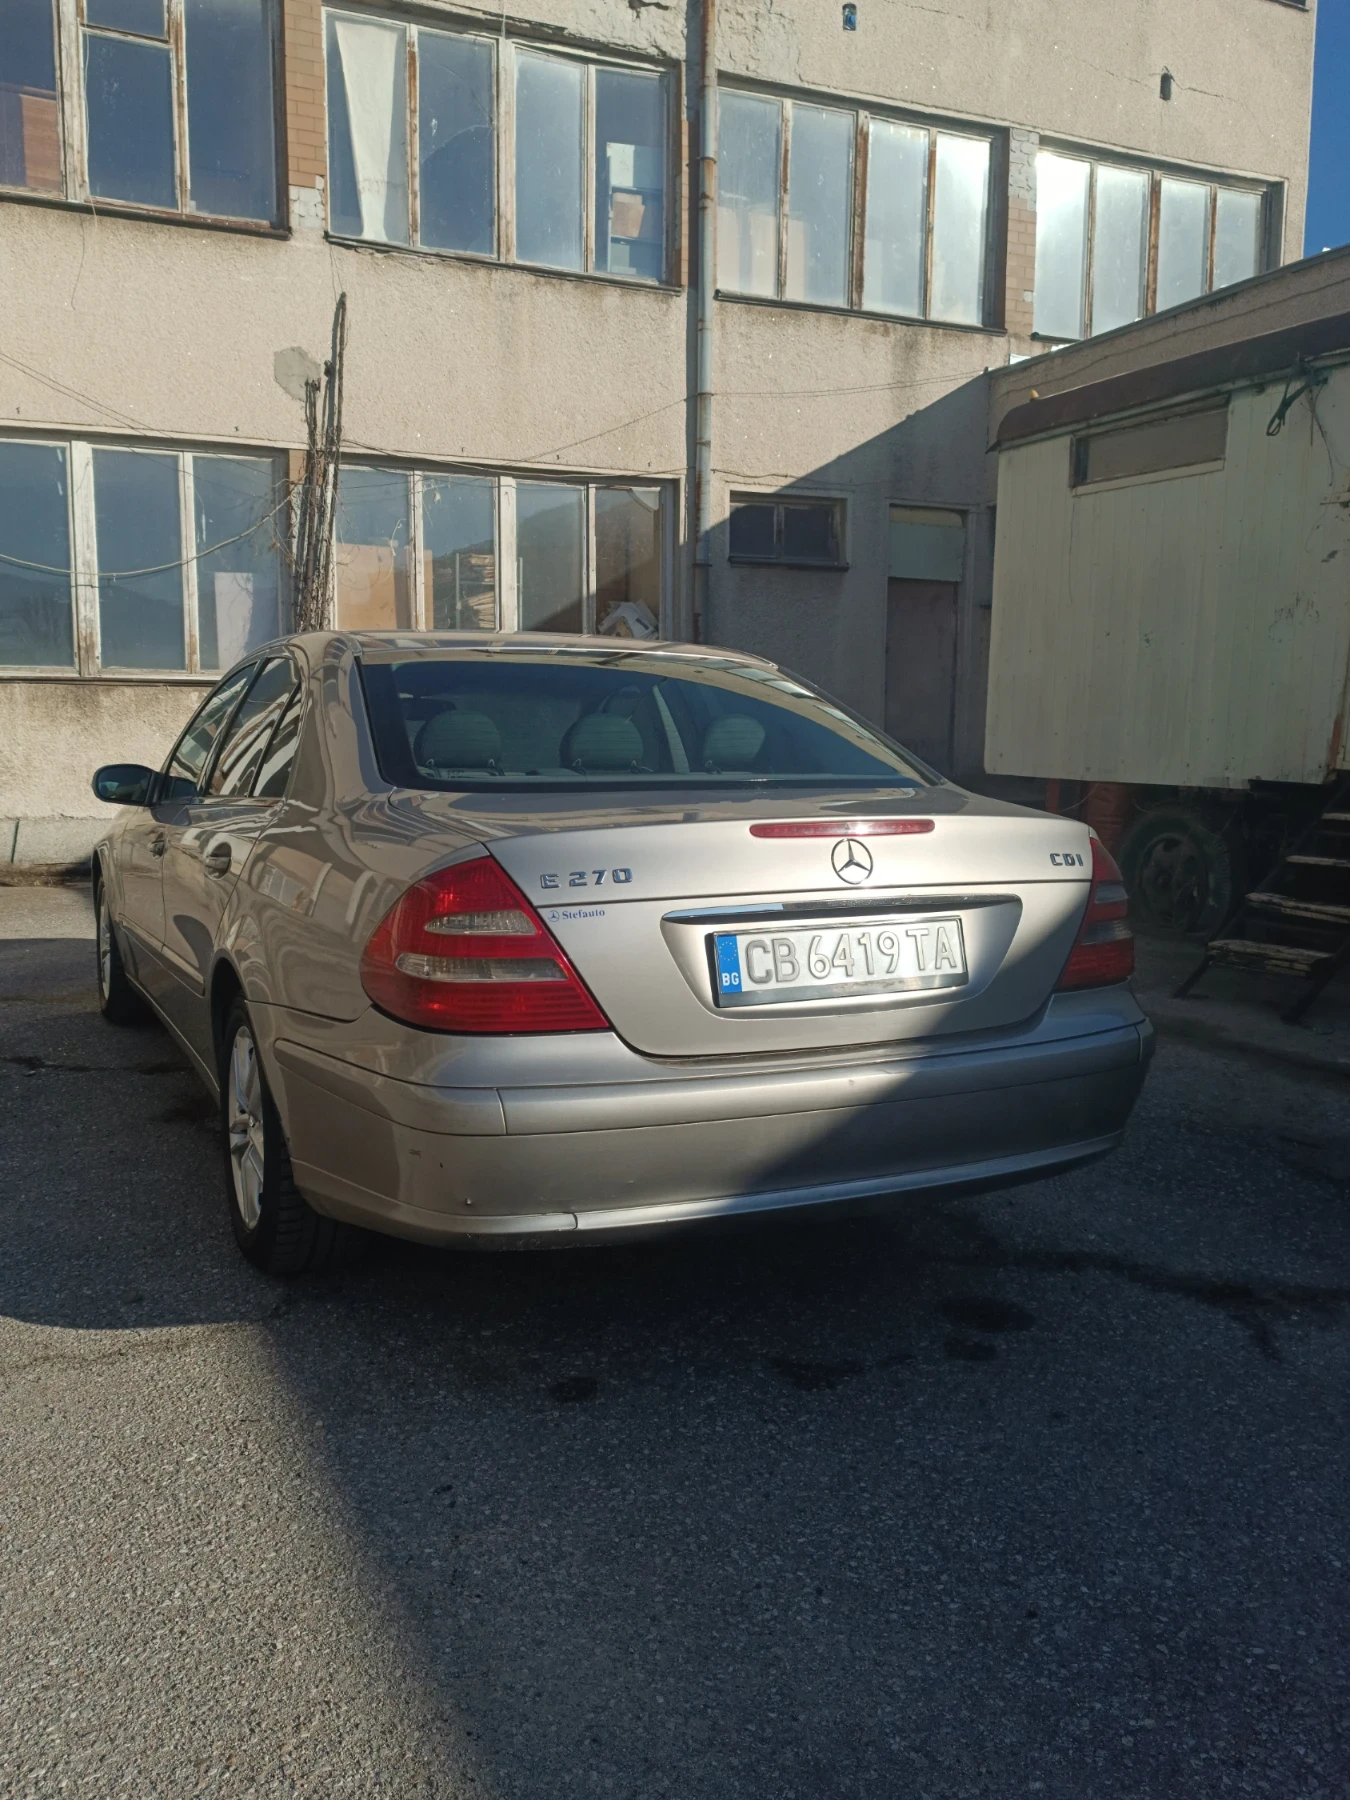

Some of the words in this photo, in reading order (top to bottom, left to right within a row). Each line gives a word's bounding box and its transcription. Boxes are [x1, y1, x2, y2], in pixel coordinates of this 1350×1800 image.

[1049, 853, 1084, 867] CDI
[540, 873, 561, 889] E
[568, 867, 633, 887] 270
[561, 909, 606, 920] Stefauto
[746, 937, 801, 984] CB
[807, 930, 900, 980] 6419
[906, 926, 957, 971] TA
[722, 972, 740, 987] BG
